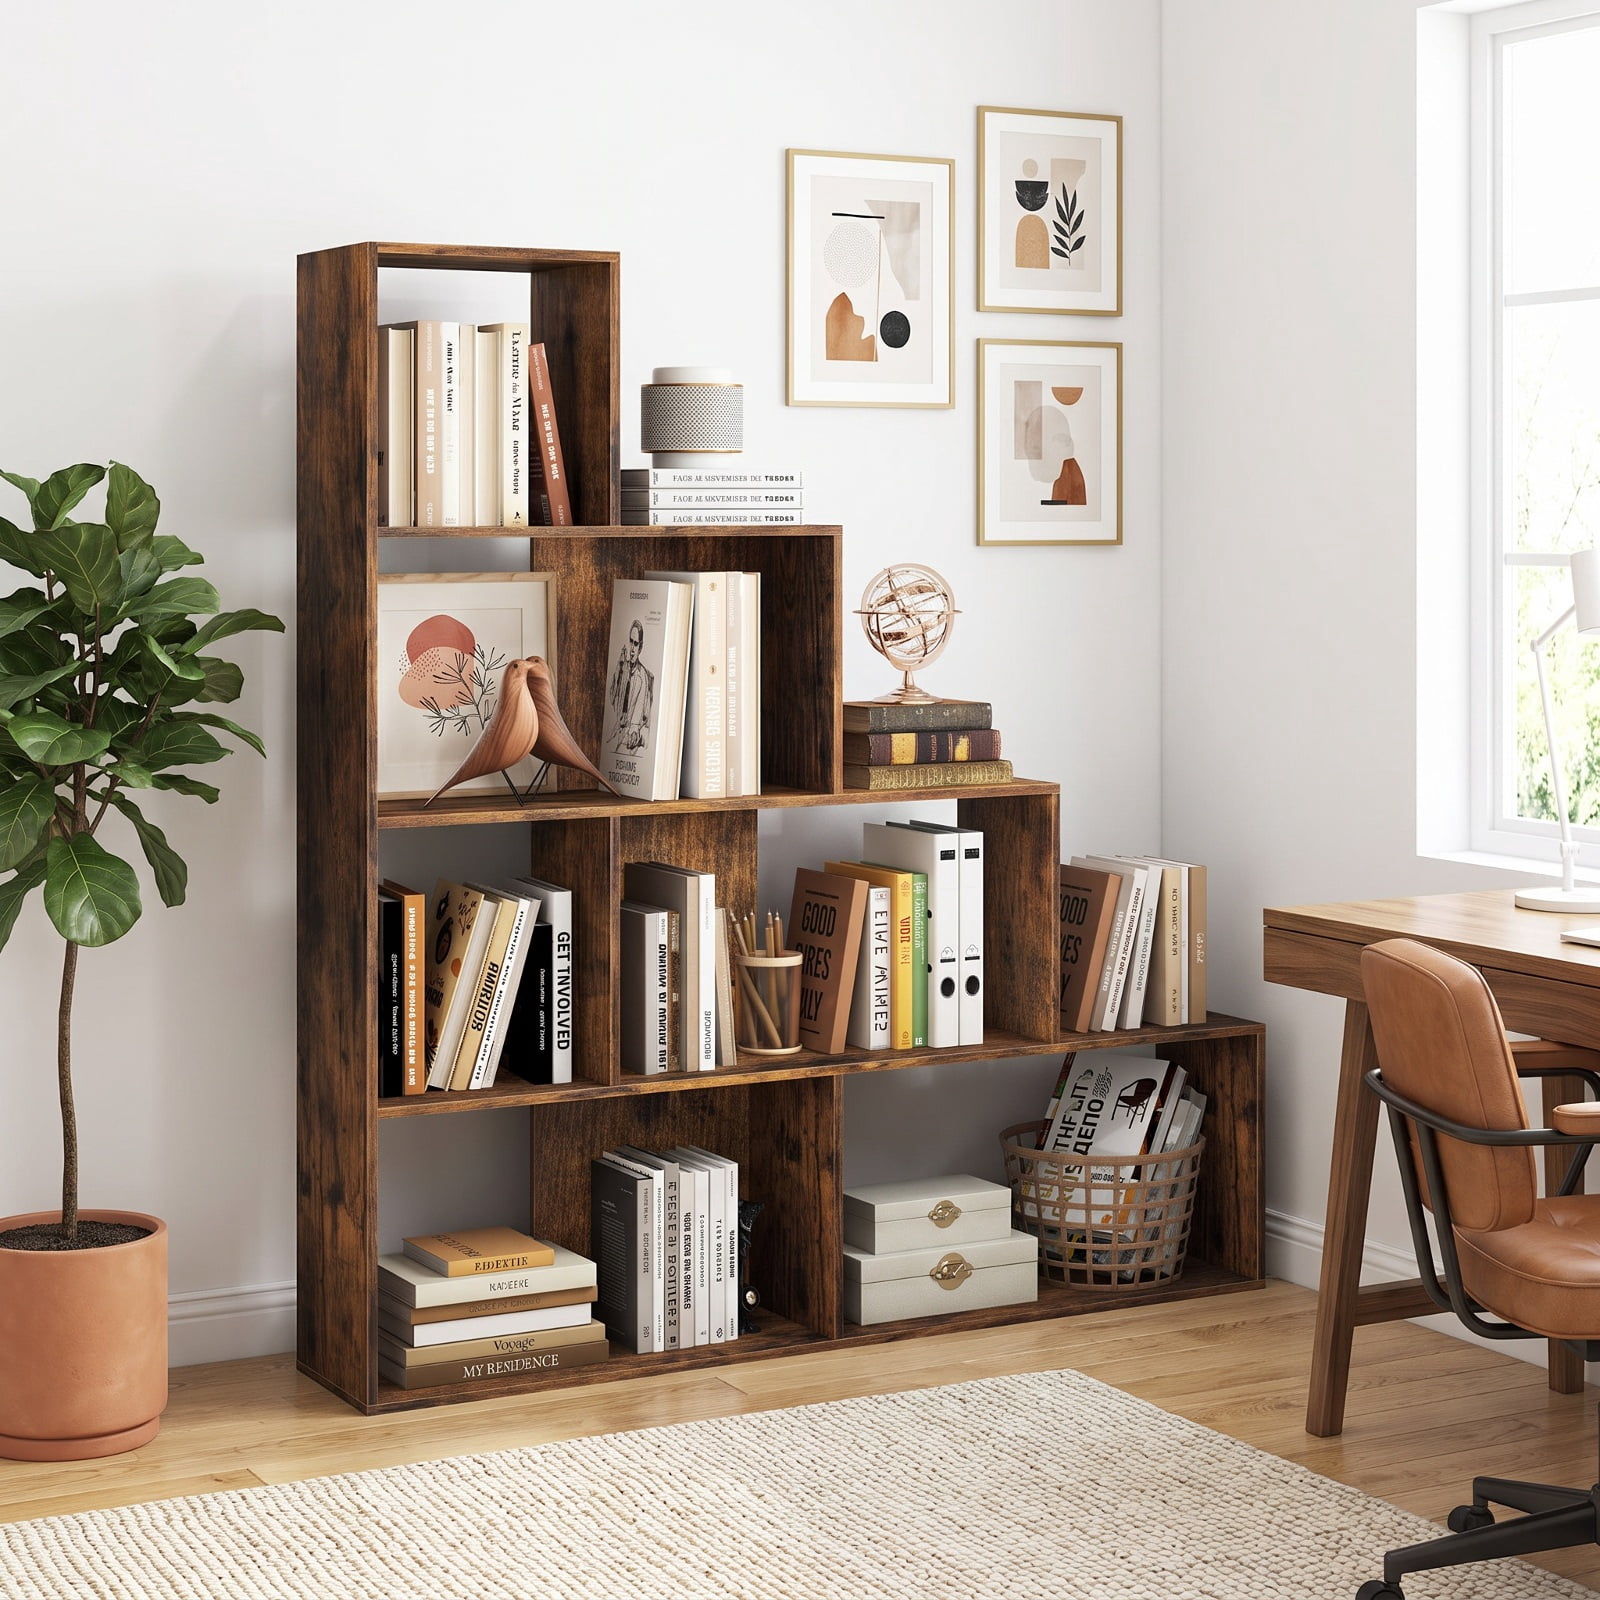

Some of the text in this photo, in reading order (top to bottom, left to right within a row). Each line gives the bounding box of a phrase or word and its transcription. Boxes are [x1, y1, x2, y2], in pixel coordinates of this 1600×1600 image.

[802, 901, 837, 938] GOOD
[1059, 892, 1089, 926] OOD
[557, 931, 571, 962] GET
[494, 1338, 536, 1353] Voyage
[462, 1353, 560, 1379] MY RESIDENCE
